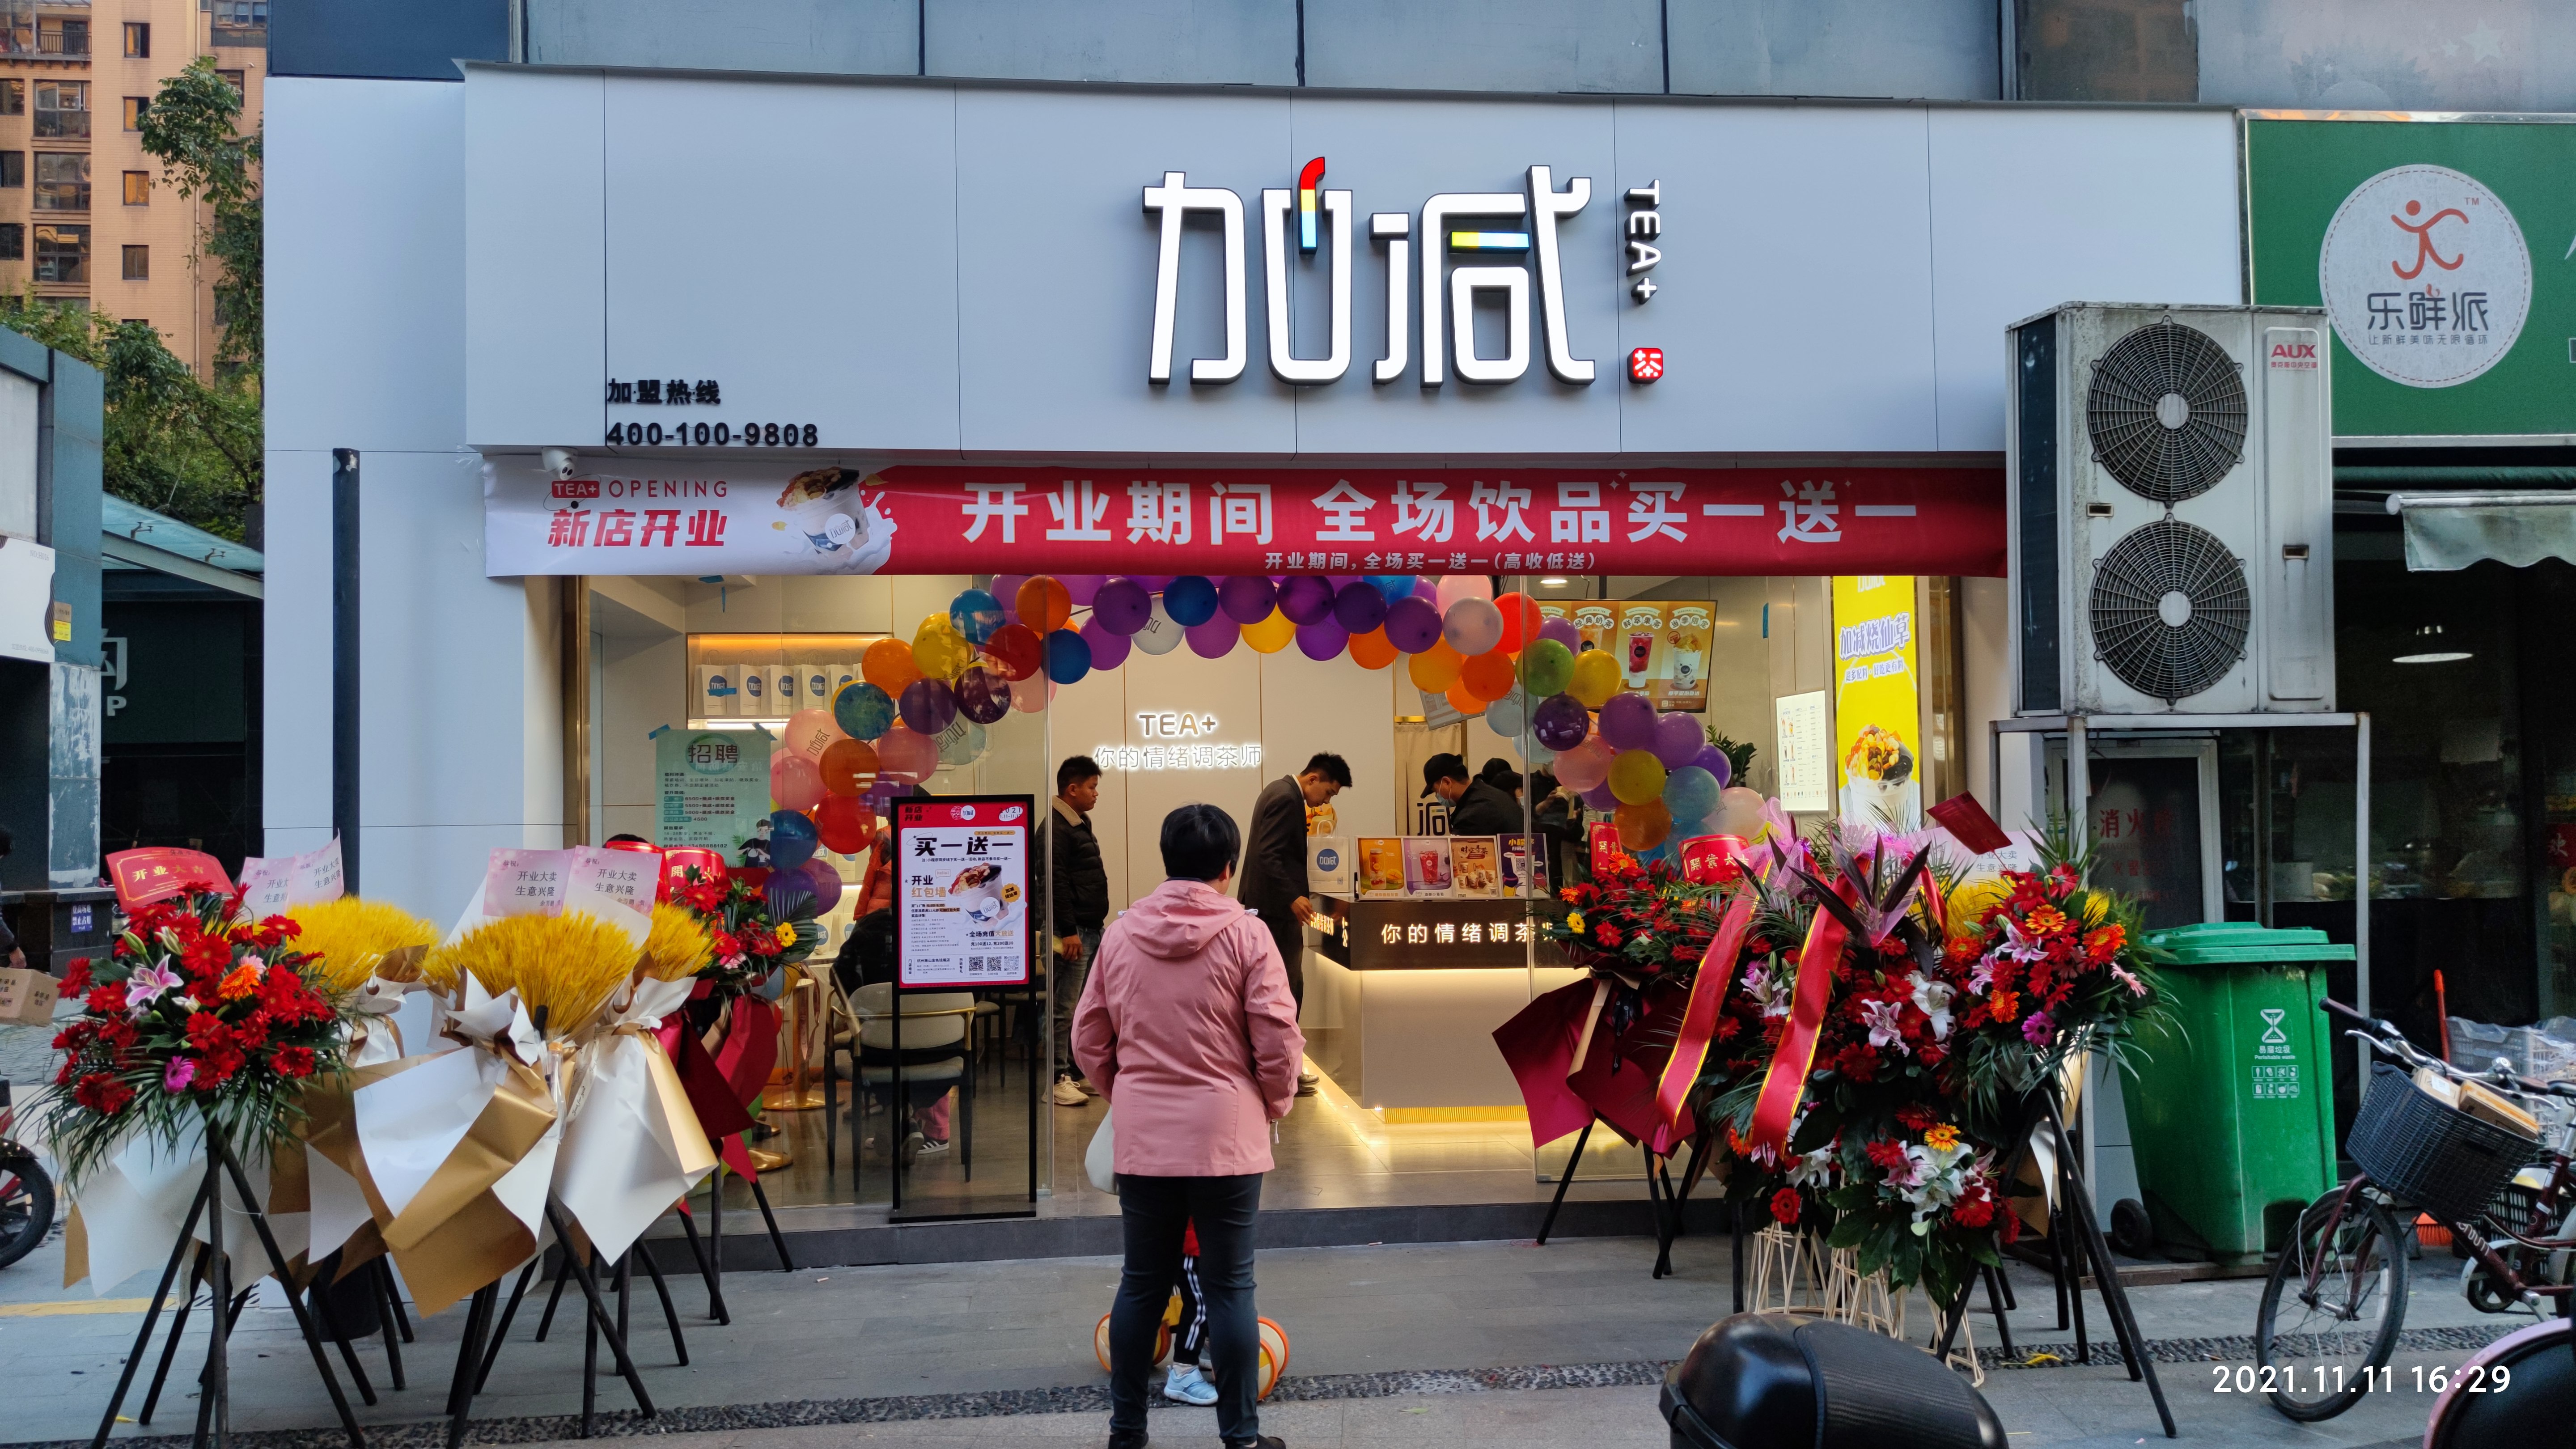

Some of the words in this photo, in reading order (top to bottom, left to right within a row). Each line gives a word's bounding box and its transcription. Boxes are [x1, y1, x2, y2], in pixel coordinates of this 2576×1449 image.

[1142, 157, 1595, 388] 加减
[2368, 291, 2489, 331] 乐鲜派
[2368, 334, 2488, 345] 让新鲜美味无限循环
[2271, 345, 2316, 358] AUX
[607, 379, 721, 404] 加盟热线
[607, 422, 818, 446] 400-100-9808
[554, 483, 598, 496] TEA+
[608, 480, 728, 498] OPENING
[961, 479, 1274, 545] 开业期间
[547, 508, 728, 547] 新店开业
[1575, 616, 1613, 628] 经典奶茶
[1671, 617, 1708, 628] 当季限定
[1839, 613, 1910, 660] 加减烧仙草
[1139, 714, 1216, 736] TEA+
[688, 744, 739, 763] 招聘
[1094, 746, 1262, 768] 你的情绪调茶师
[915, 836, 1014, 856] 买一送一
[132, 865, 203, 882] 开业大吉
[517, 870, 557, 882] 开业大卖
[597, 869, 637, 881] 开业大卖
[911, 875, 933, 886] 开业
[267, 877, 289, 889] 开业大
[594, 882, 635, 895] 生意兴隆
[263, 893, 288, 903] 生意兴
[515, 886, 555, 897] 生意兴隆
[911, 887, 946, 898] 红包墙
[72, 915, 91, 925] 禁止占用
[1381, 923, 1553, 944] 你的情绪调茶
[2259, 1045, 2291, 1054] 易腐垃圾
